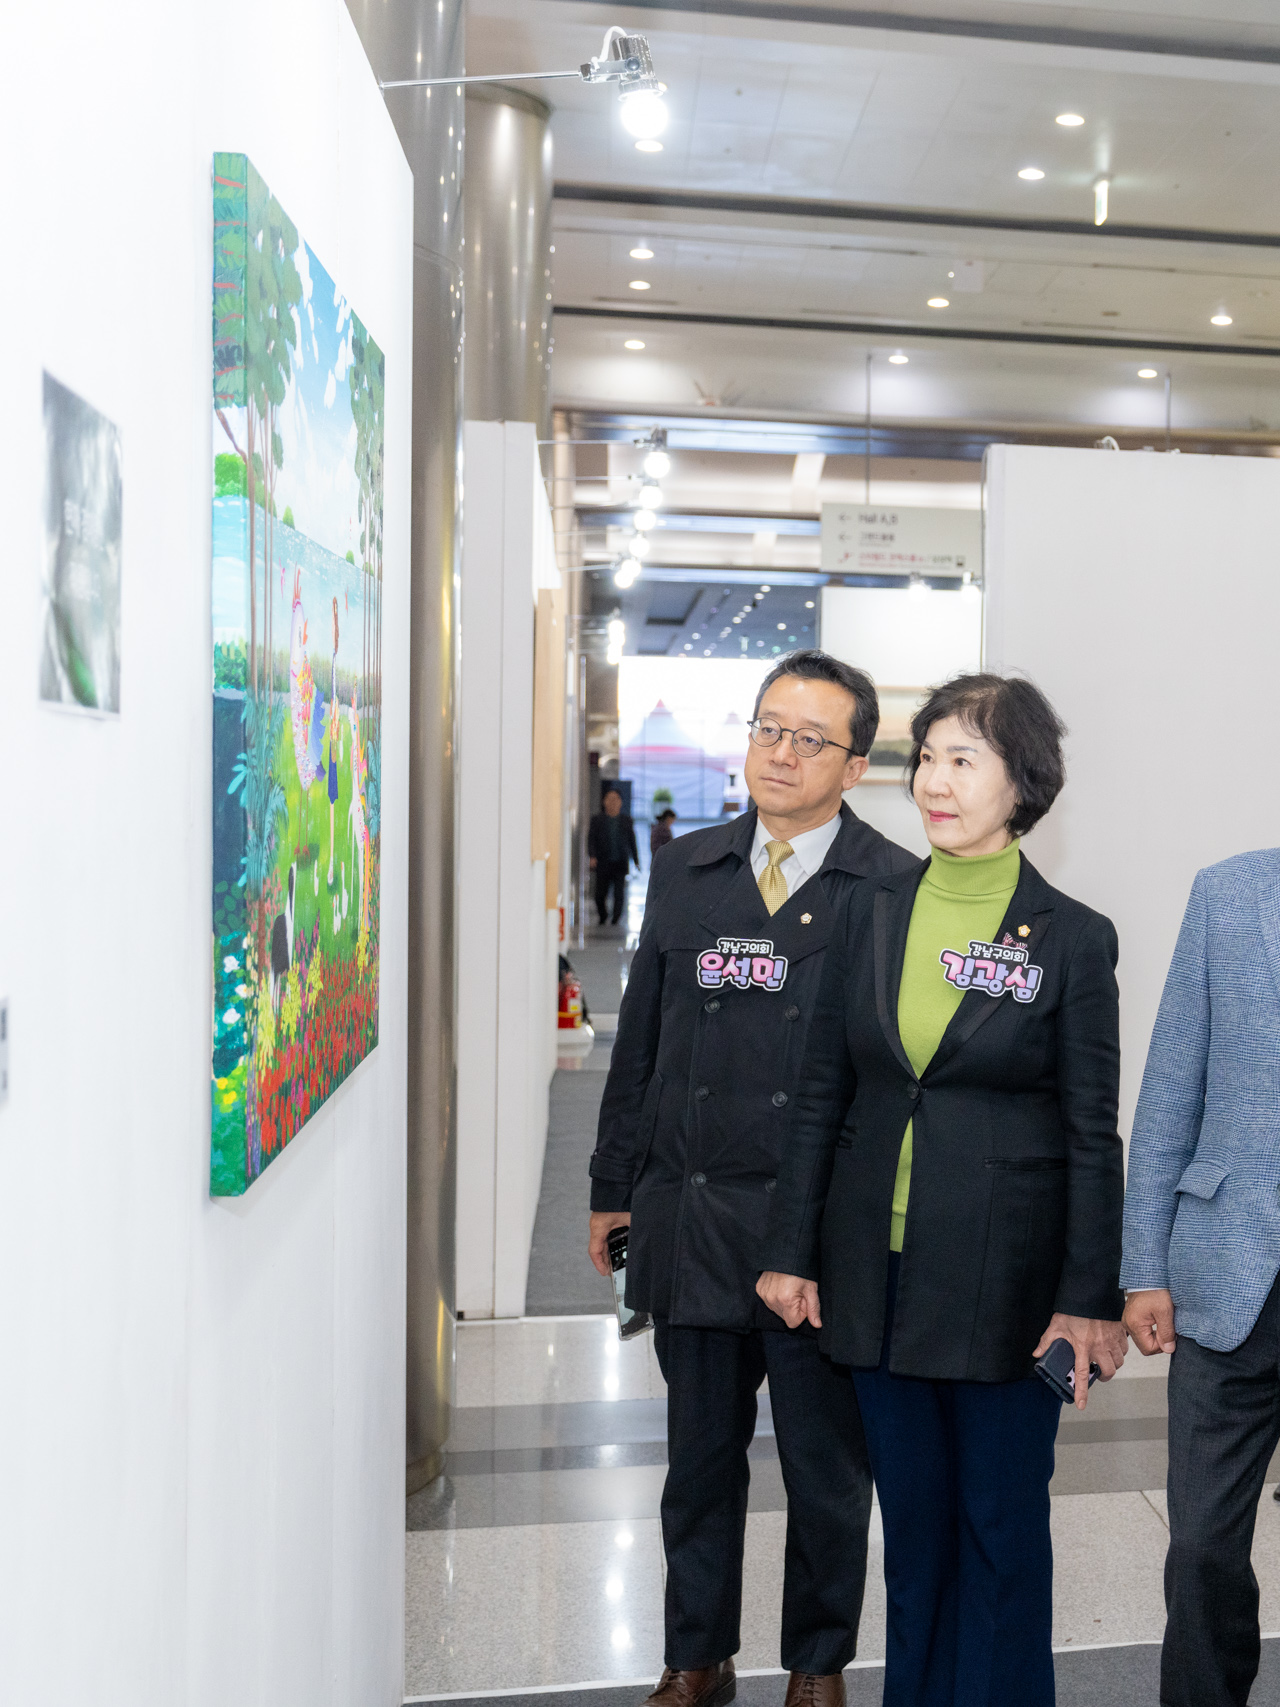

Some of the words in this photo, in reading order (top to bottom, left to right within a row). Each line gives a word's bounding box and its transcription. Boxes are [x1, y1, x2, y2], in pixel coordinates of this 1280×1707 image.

[720, 941, 769, 954] 강남구의회
[971, 944, 1025, 962] 강남구의회
[700, 952, 785, 987] 윤석민
[942, 952, 1039, 999] 김광심
